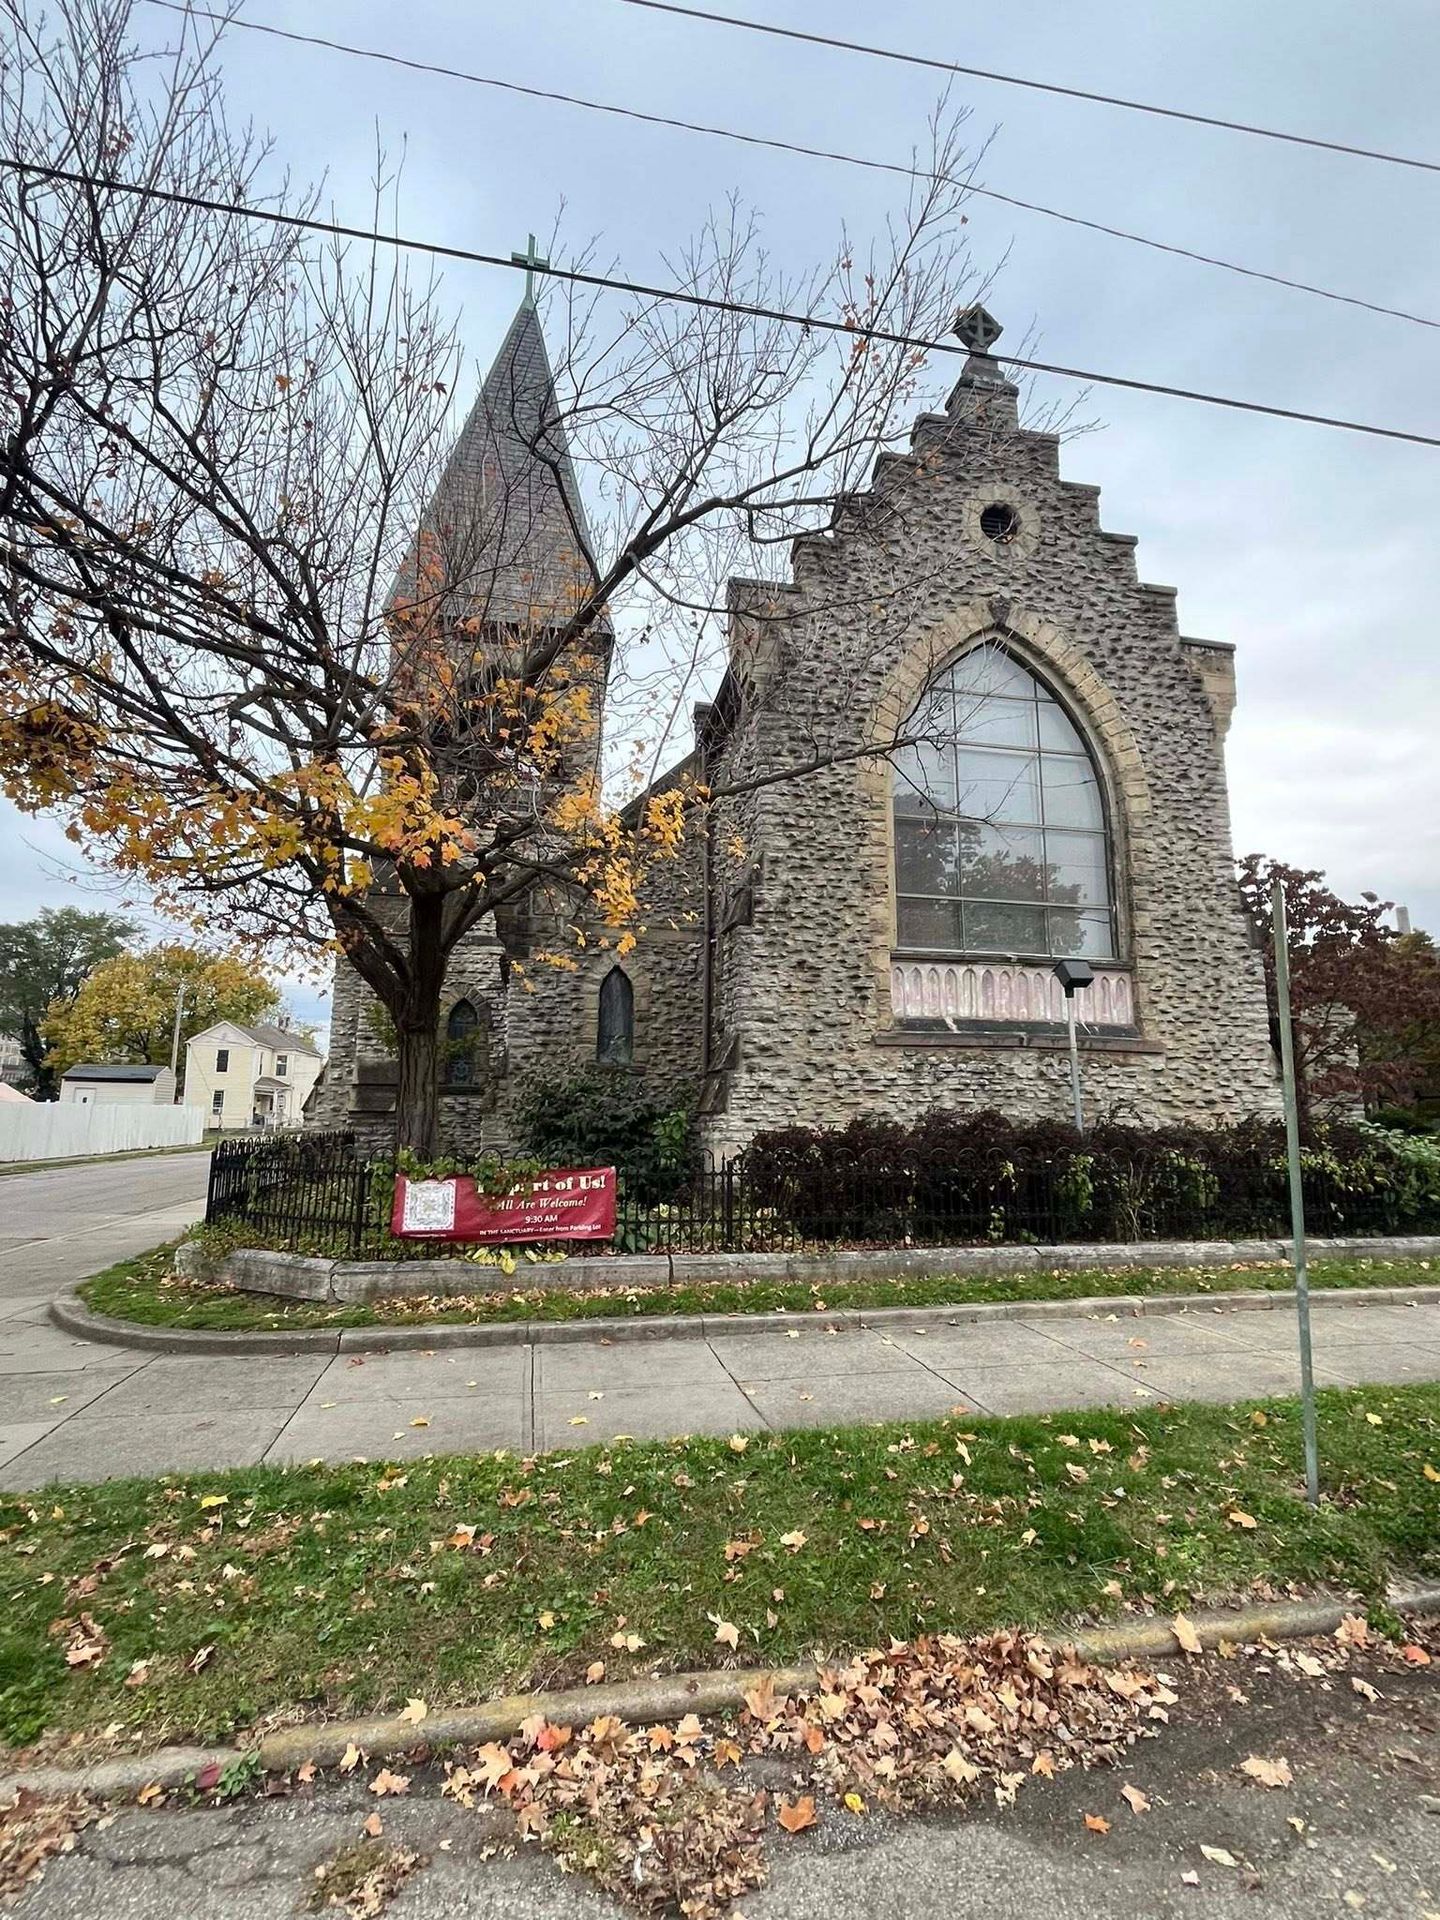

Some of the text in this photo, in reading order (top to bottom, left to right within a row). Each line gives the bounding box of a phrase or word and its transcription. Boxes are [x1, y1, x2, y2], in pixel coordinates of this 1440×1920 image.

[508, 1175, 606, 1196] prt of Us!
[497, 1196, 588, 1210] All Are Welcome!
[525, 1215, 542, 1224] 9:30
